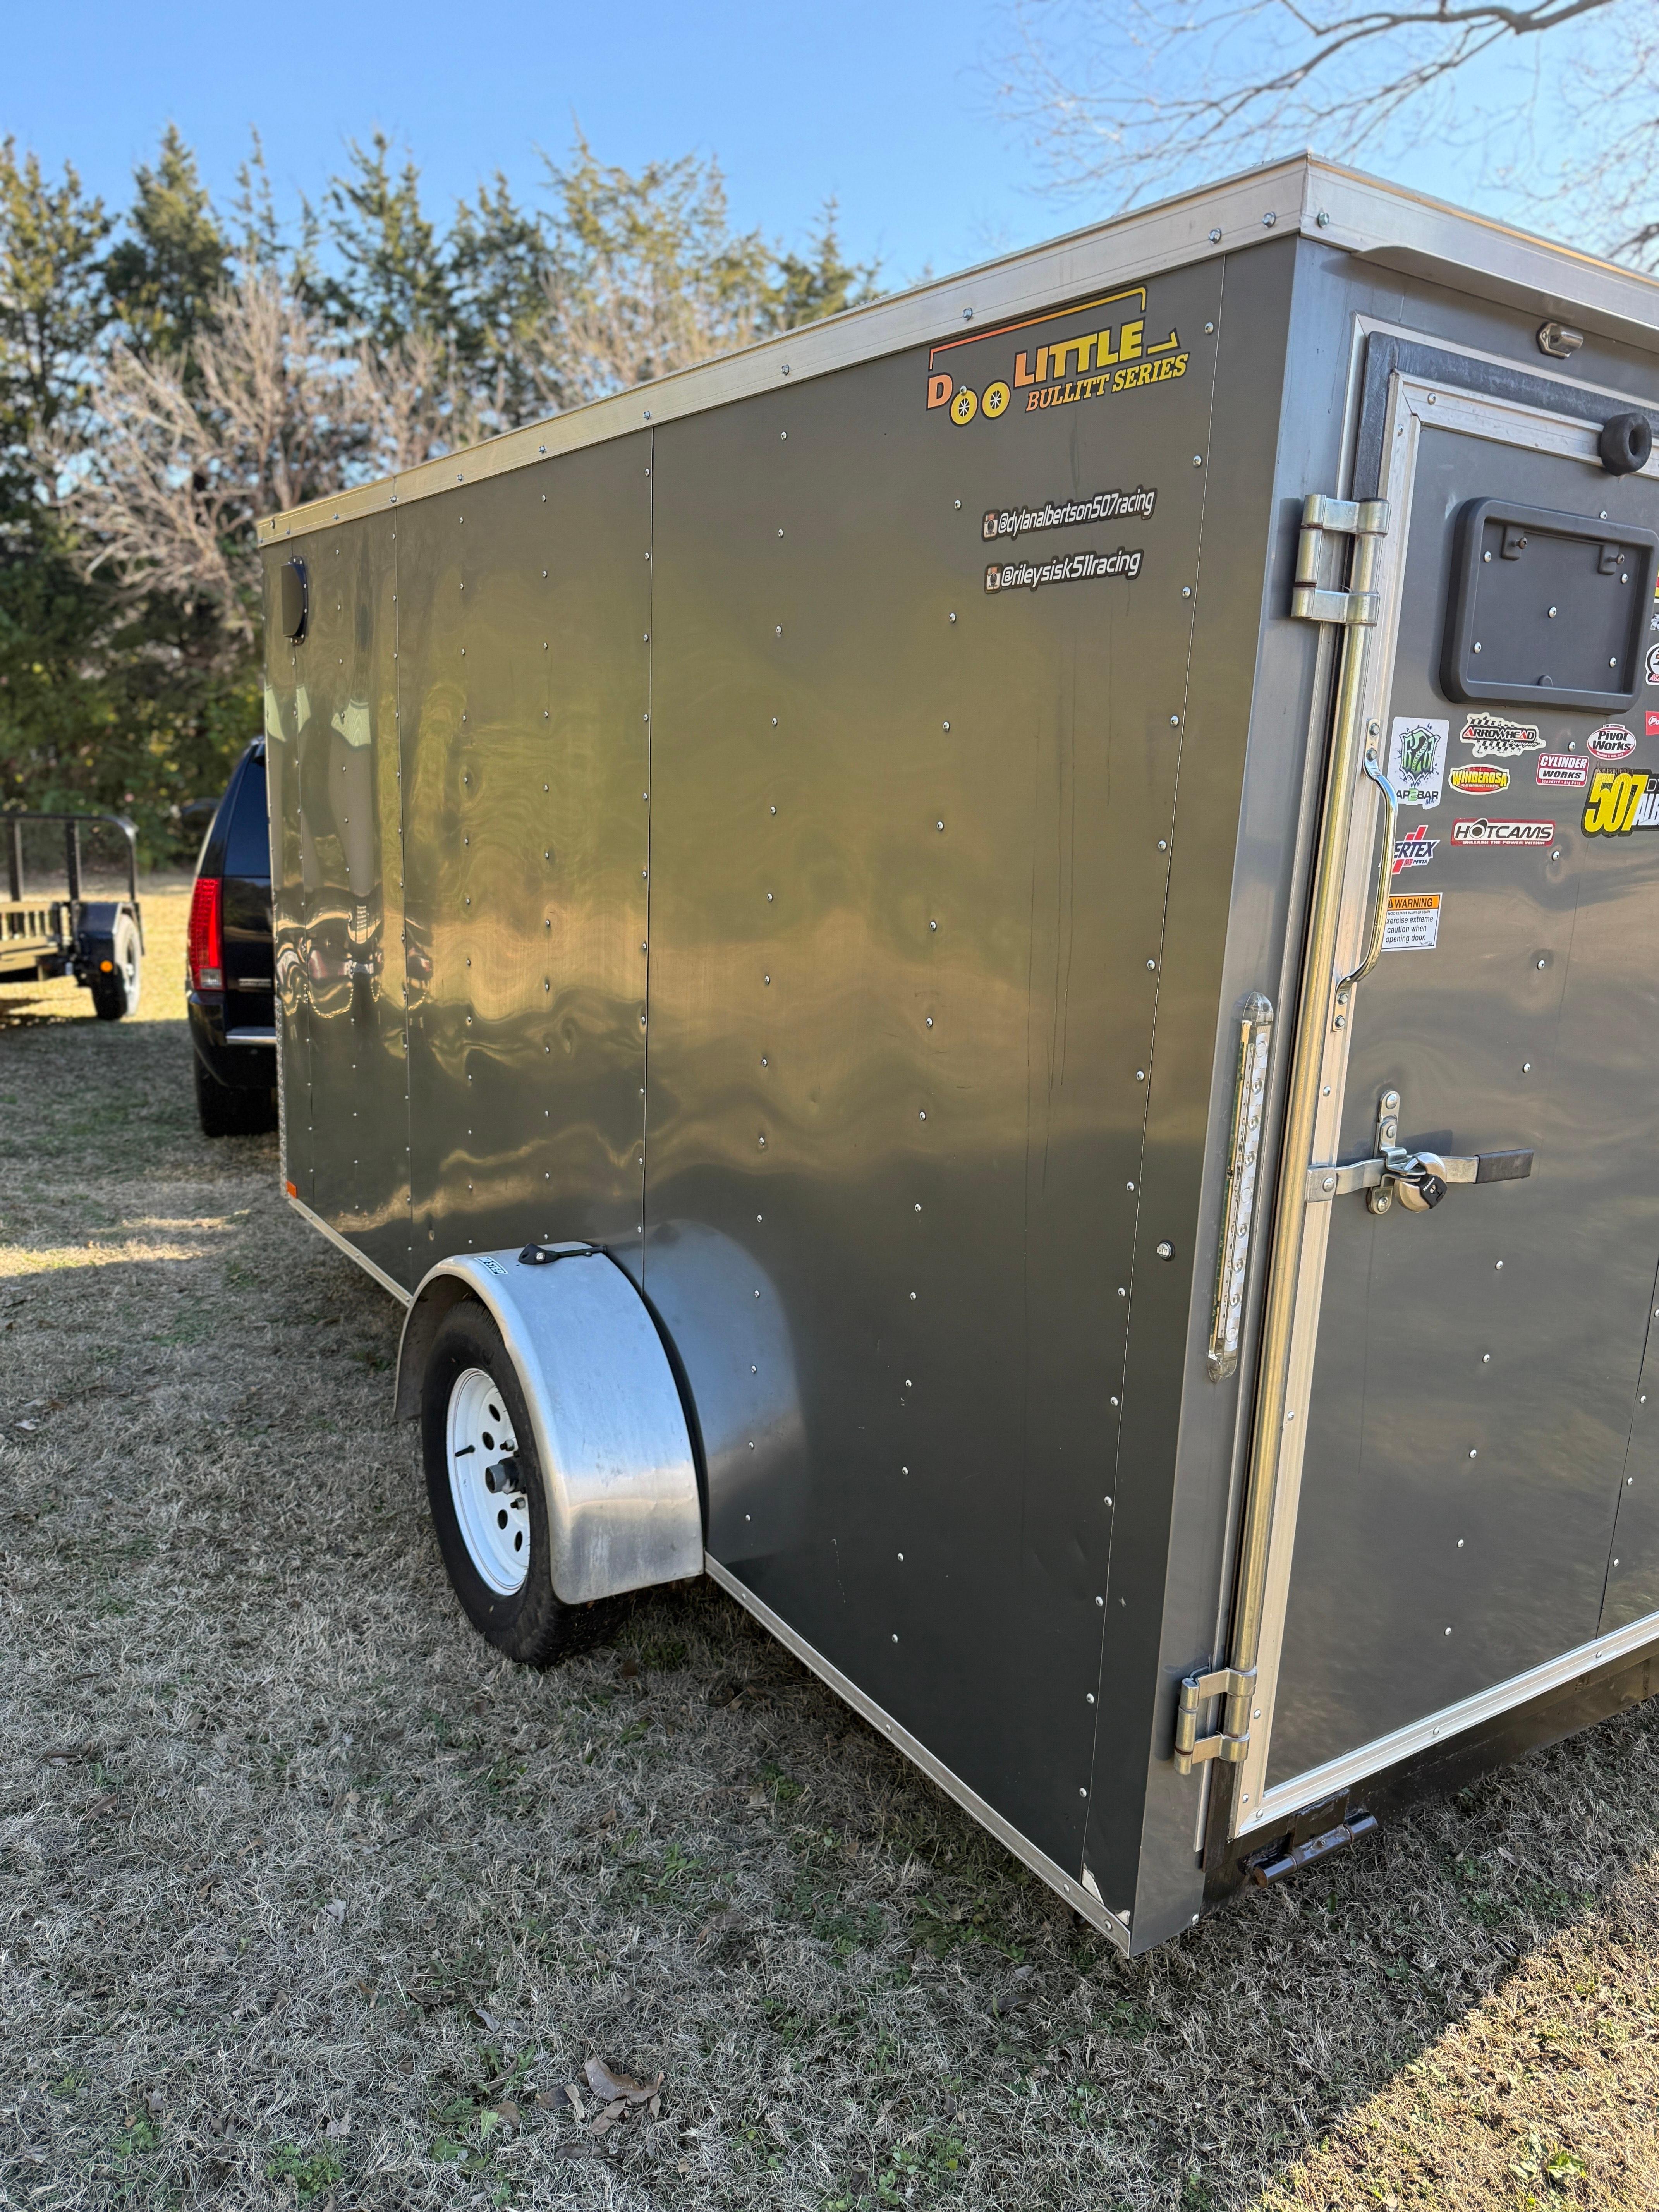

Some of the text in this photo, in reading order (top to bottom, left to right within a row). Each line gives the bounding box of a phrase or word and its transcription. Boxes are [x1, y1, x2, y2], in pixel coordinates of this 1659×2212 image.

[1026, 354, 1188, 412] BULLITT SERIES
[998, 488, 1155, 536] @dylanalbertson507racing
[1001, 550, 1141, 587] @rileysisk511racing
[1464, 728, 1535, 740] ARROWHEAD
[1598, 731, 1628, 741] Pivot
[1593, 740, 1632, 750] Works
[1540, 756, 1587, 769] CYLINDER
[1453, 770, 1507, 787] WINDEROSA
[1542, 770, 1582, 779] WORKS
[1396, 788, 1439, 801] AR2BAR
[1584, 773, 1649, 832] 507
[1455, 819, 1553, 839] HOTCAMS
[1394, 841, 1437, 858] ERTEX
[1395, 898, 1432, 908] WARNING
[1386, 934, 1409, 944] opening
